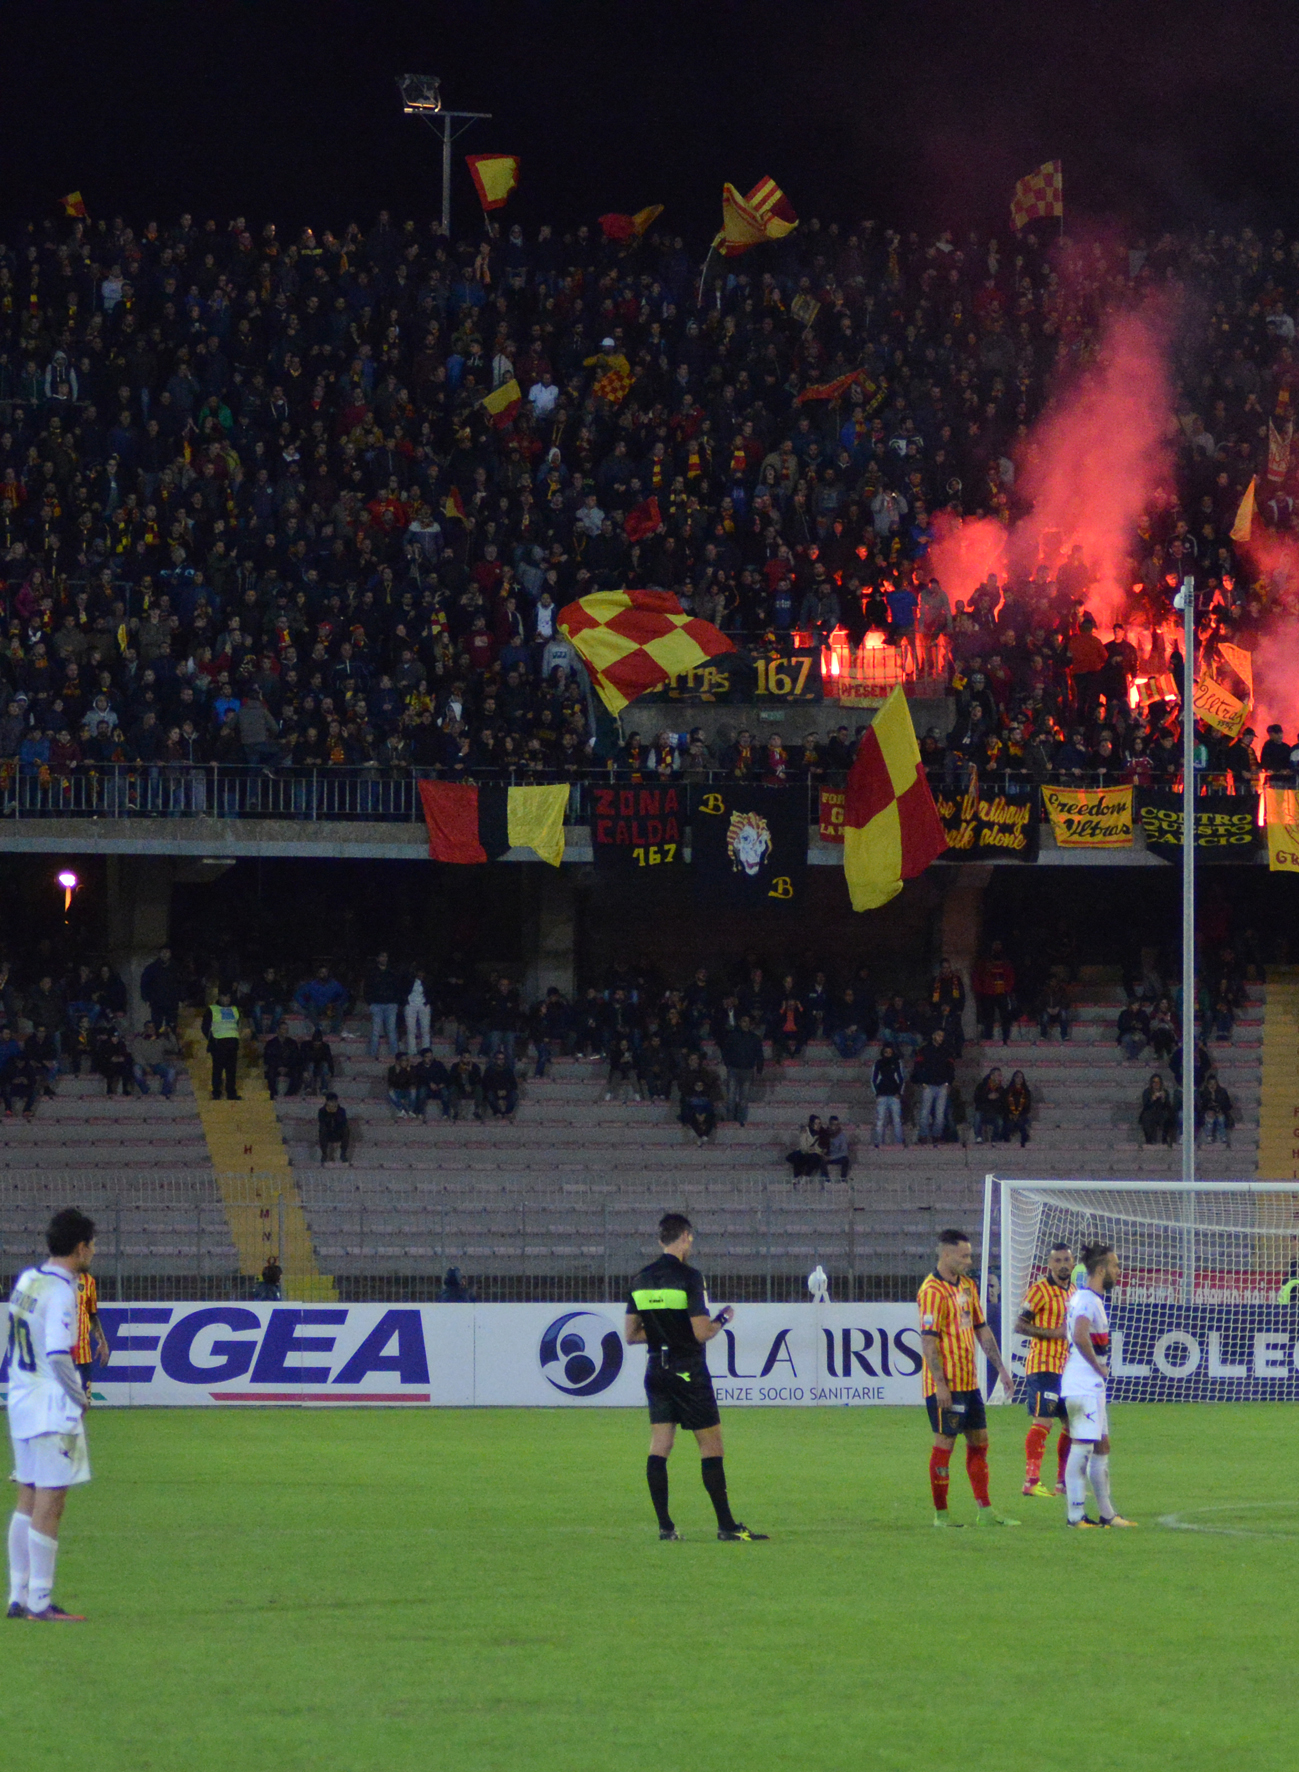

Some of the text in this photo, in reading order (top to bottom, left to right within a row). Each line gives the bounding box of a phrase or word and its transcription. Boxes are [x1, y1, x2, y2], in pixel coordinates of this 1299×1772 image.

[753, 657, 813, 695] 167
[593, 788, 679, 816] ZONA
[1049, 793, 1129, 817] Freedom
[1063, 818, 1132, 838] Ultras
[1140, 807, 1253, 825] COTRO
[1142, 818, 1253, 835] QUSTO
[596, 817, 680, 845] CALDA
[979, 826, 1027, 850] alone
[1146, 832, 1253, 846] CACIO
[632, 843, 677, 867] 167
[0, 1307, 430, 1385] EGEA
[822, 1328, 923, 1377] IRIS
[716, 1386, 885, 1401] ENZE SOCIO SANITARIE
